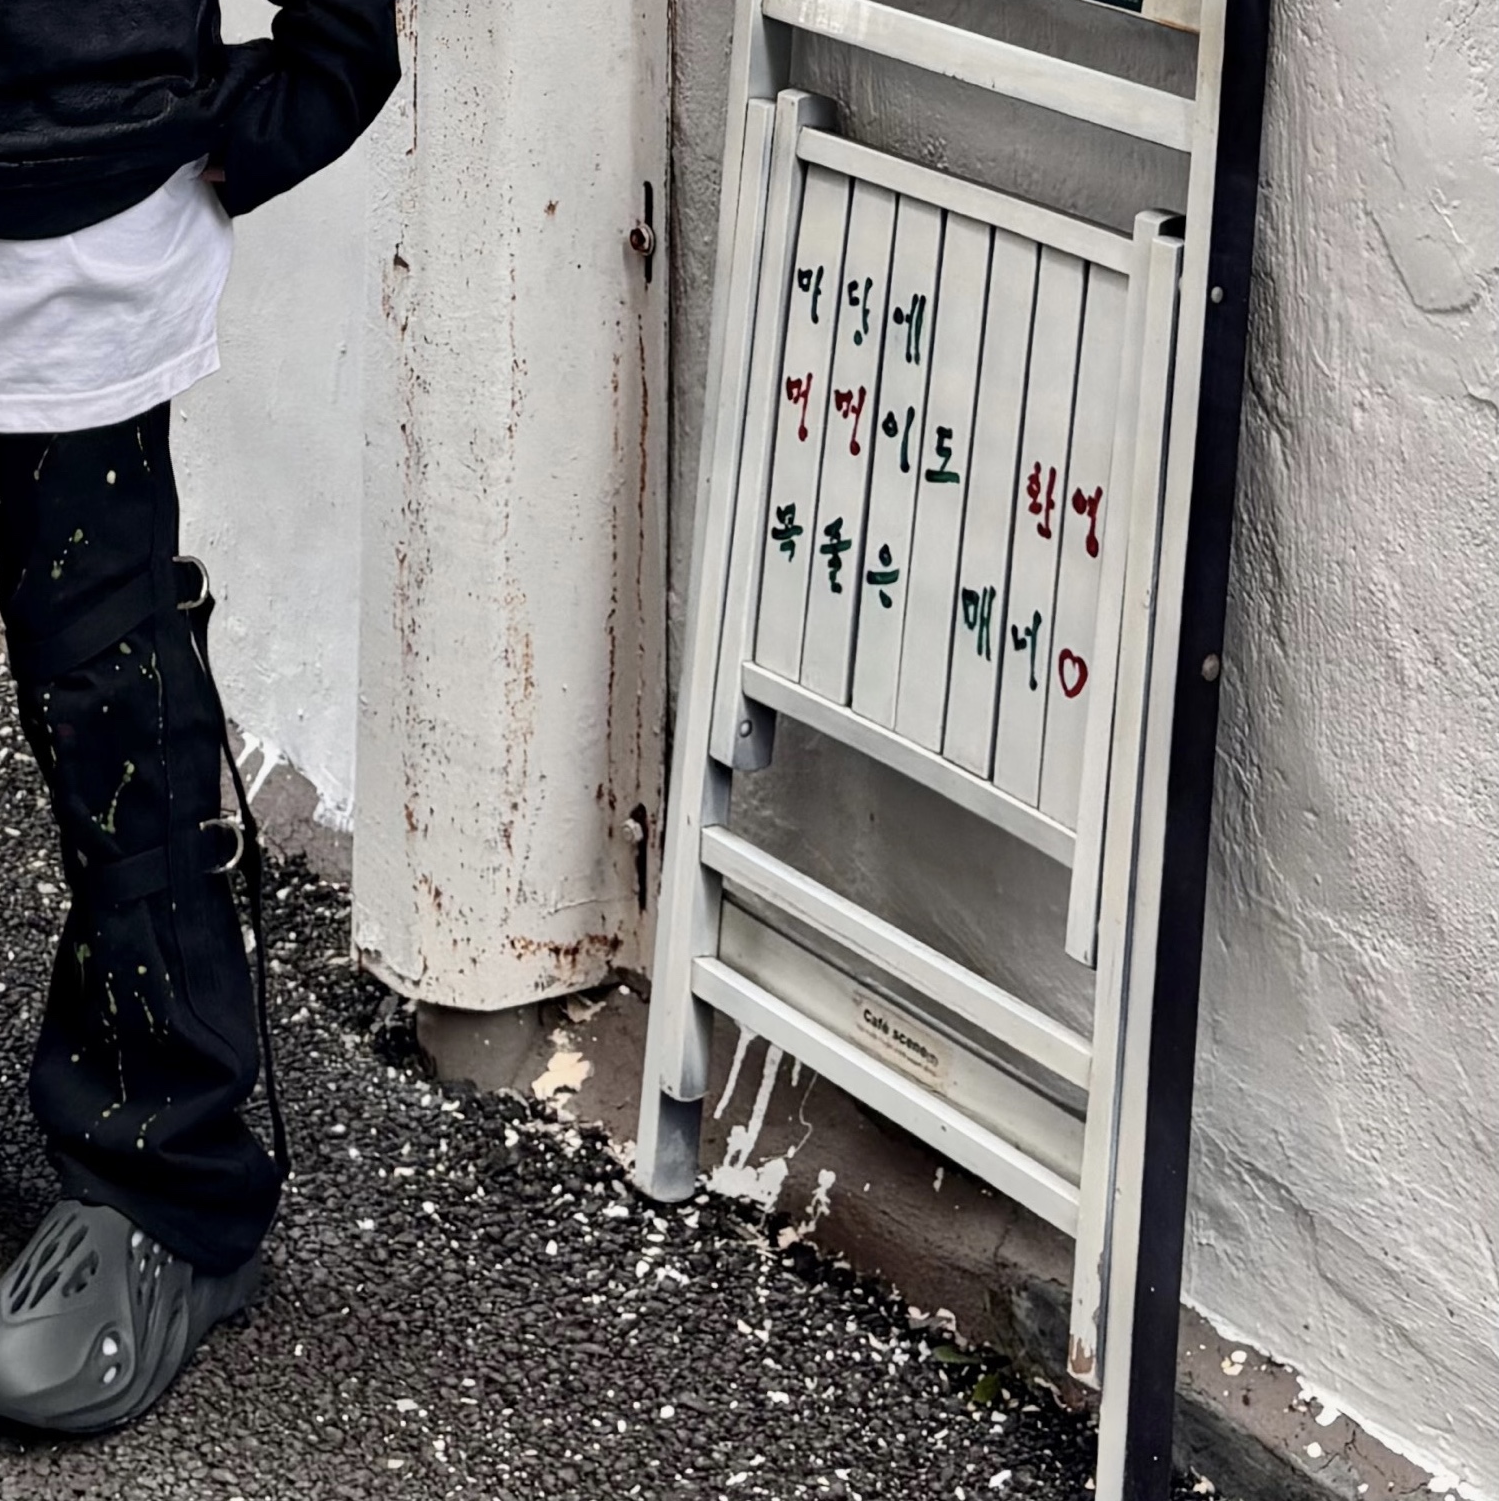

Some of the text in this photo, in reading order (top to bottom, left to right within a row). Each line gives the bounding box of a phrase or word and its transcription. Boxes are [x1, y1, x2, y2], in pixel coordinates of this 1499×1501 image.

[797, 265, 926, 366] 마당에
[785, 372, 1103, 558] 멍멍이도 환영
[771, 502, 1043, 692] 목줄은 매너
